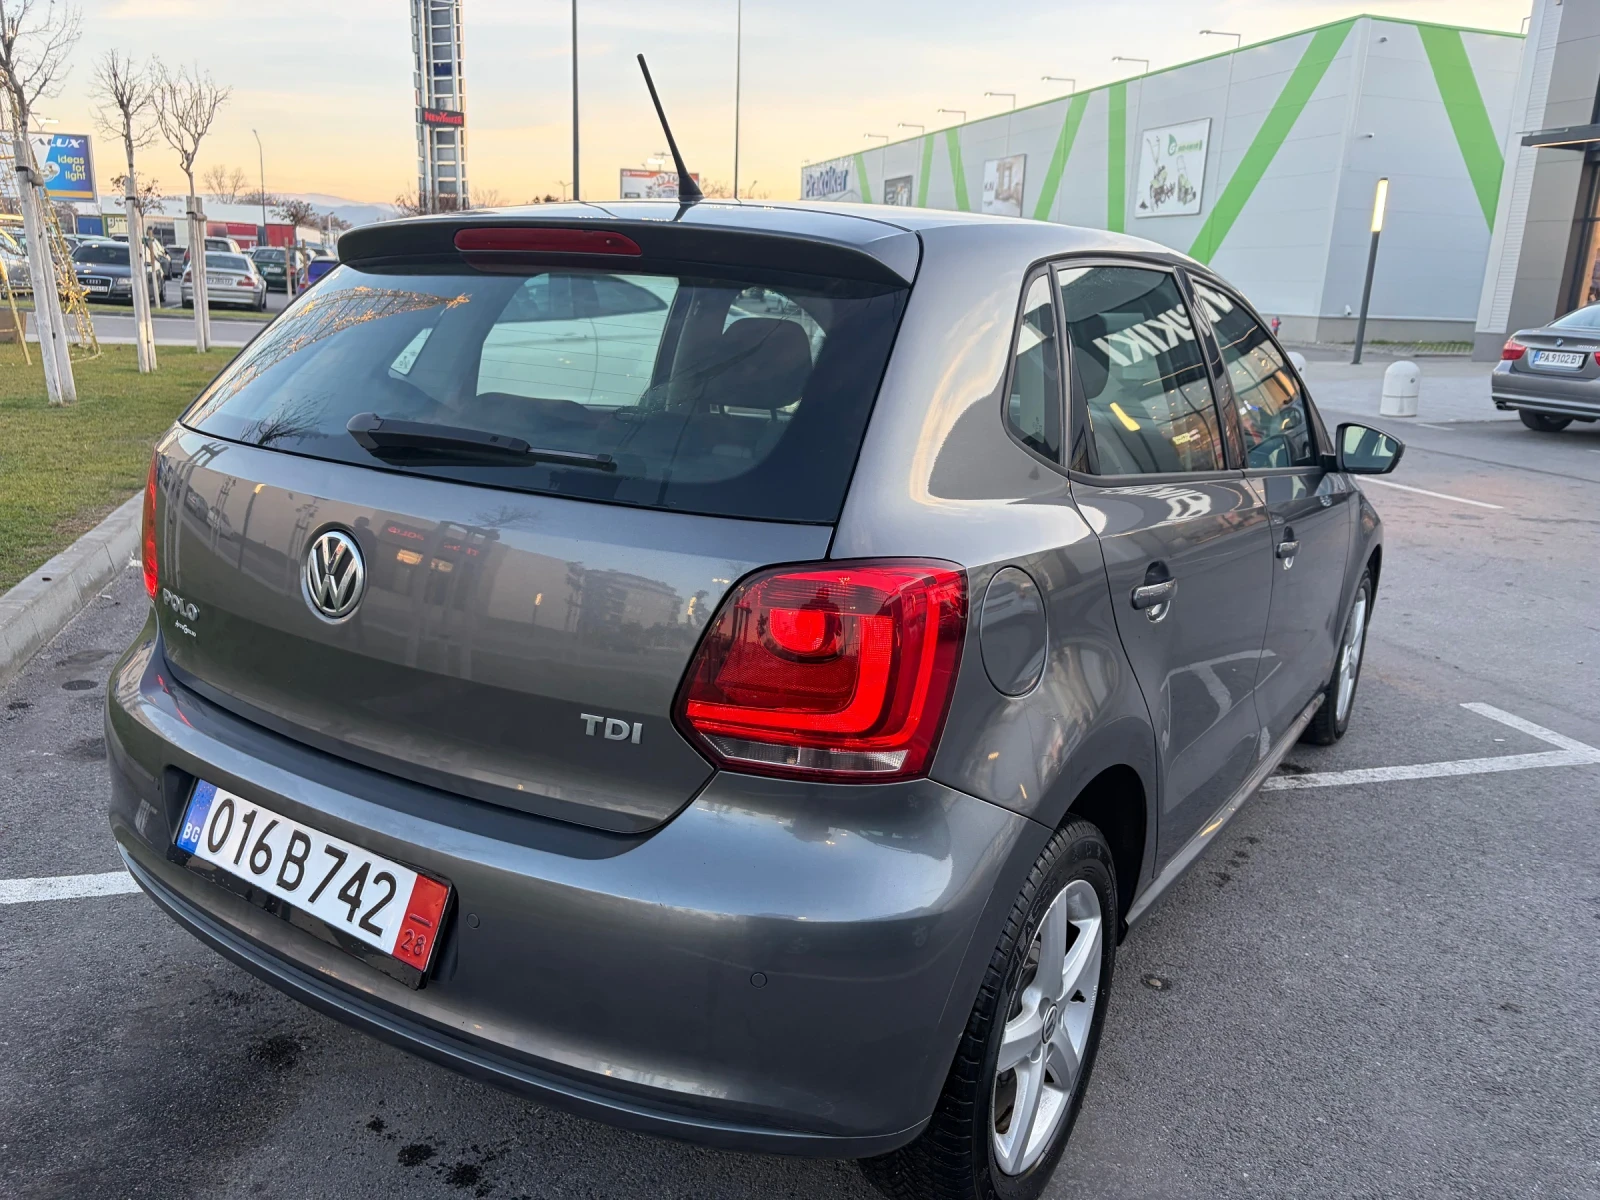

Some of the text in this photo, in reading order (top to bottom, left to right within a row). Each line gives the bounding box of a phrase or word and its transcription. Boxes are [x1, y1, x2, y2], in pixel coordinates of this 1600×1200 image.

[57, 154, 85, 164] ideas
[72, 163, 85, 172] for
[64, 170, 86, 182] light
[163, 588, 200, 622] POLO
[580, 712, 643, 745] TDI
[182, 821, 201, 844] BG
[401, 928, 427, 956] 28
